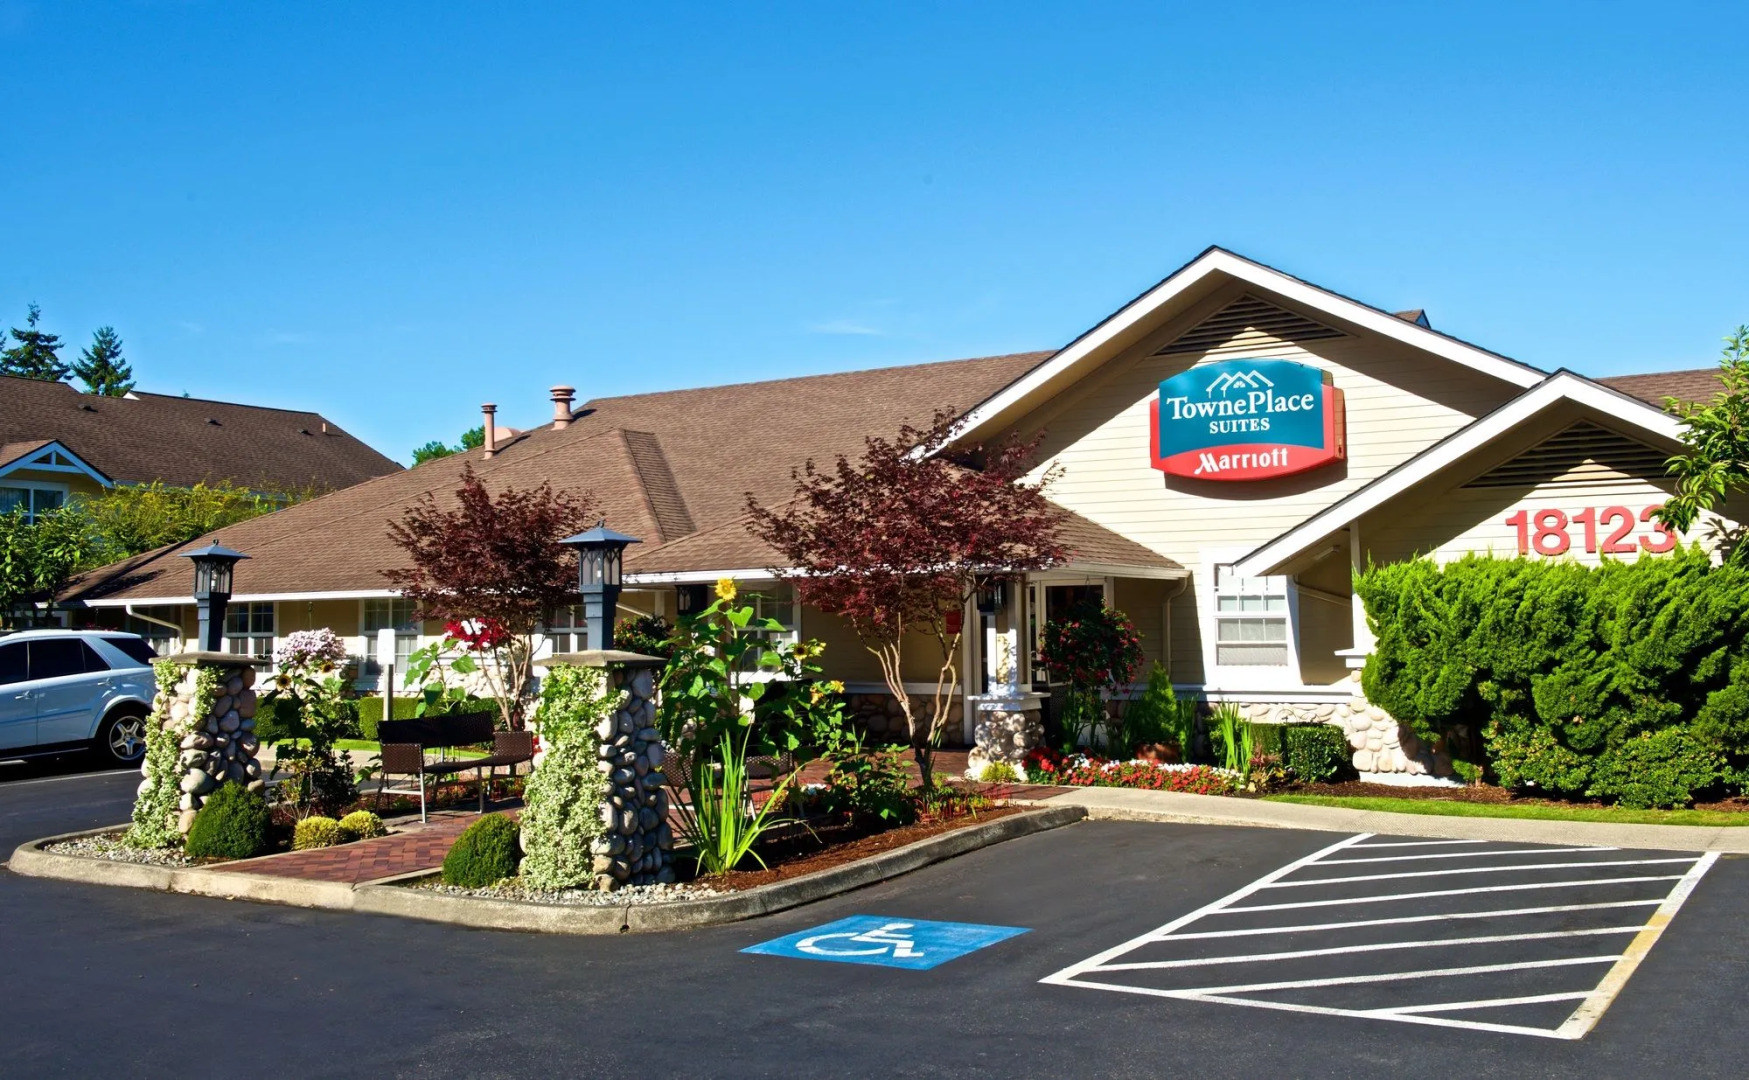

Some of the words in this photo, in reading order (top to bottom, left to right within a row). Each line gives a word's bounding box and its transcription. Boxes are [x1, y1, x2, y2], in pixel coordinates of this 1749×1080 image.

[1166, 388, 1314, 420] TownePlace
[1209, 417, 1271, 434] SUITES
[1193, 448, 1289, 475] Marriott
[1505, 504, 1678, 556] 18123
